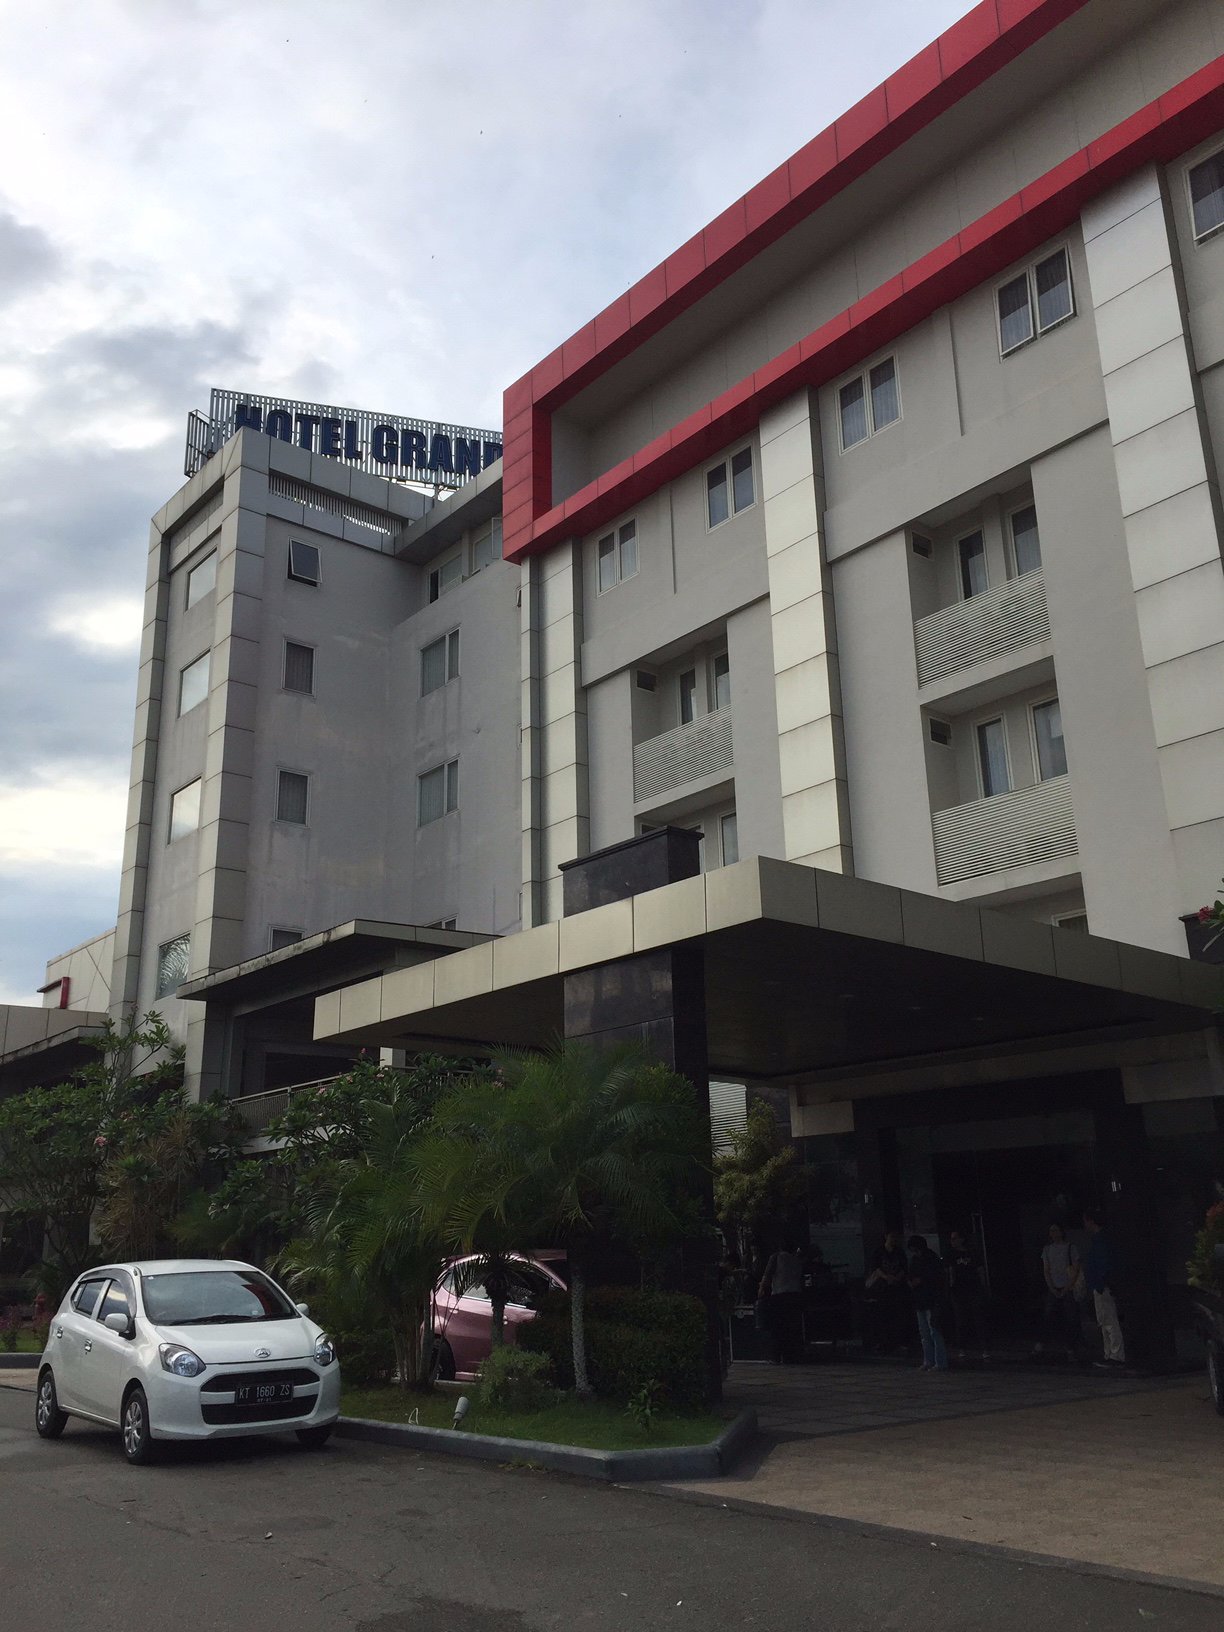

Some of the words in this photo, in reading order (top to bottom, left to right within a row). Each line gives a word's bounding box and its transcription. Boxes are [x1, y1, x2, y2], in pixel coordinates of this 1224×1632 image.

[235, 404, 362, 460] HOTEL
[239, 1388, 250, 1399] KT
[257, 1386, 275, 1398] 1660
[280, 1384, 290, 1396] ZS
